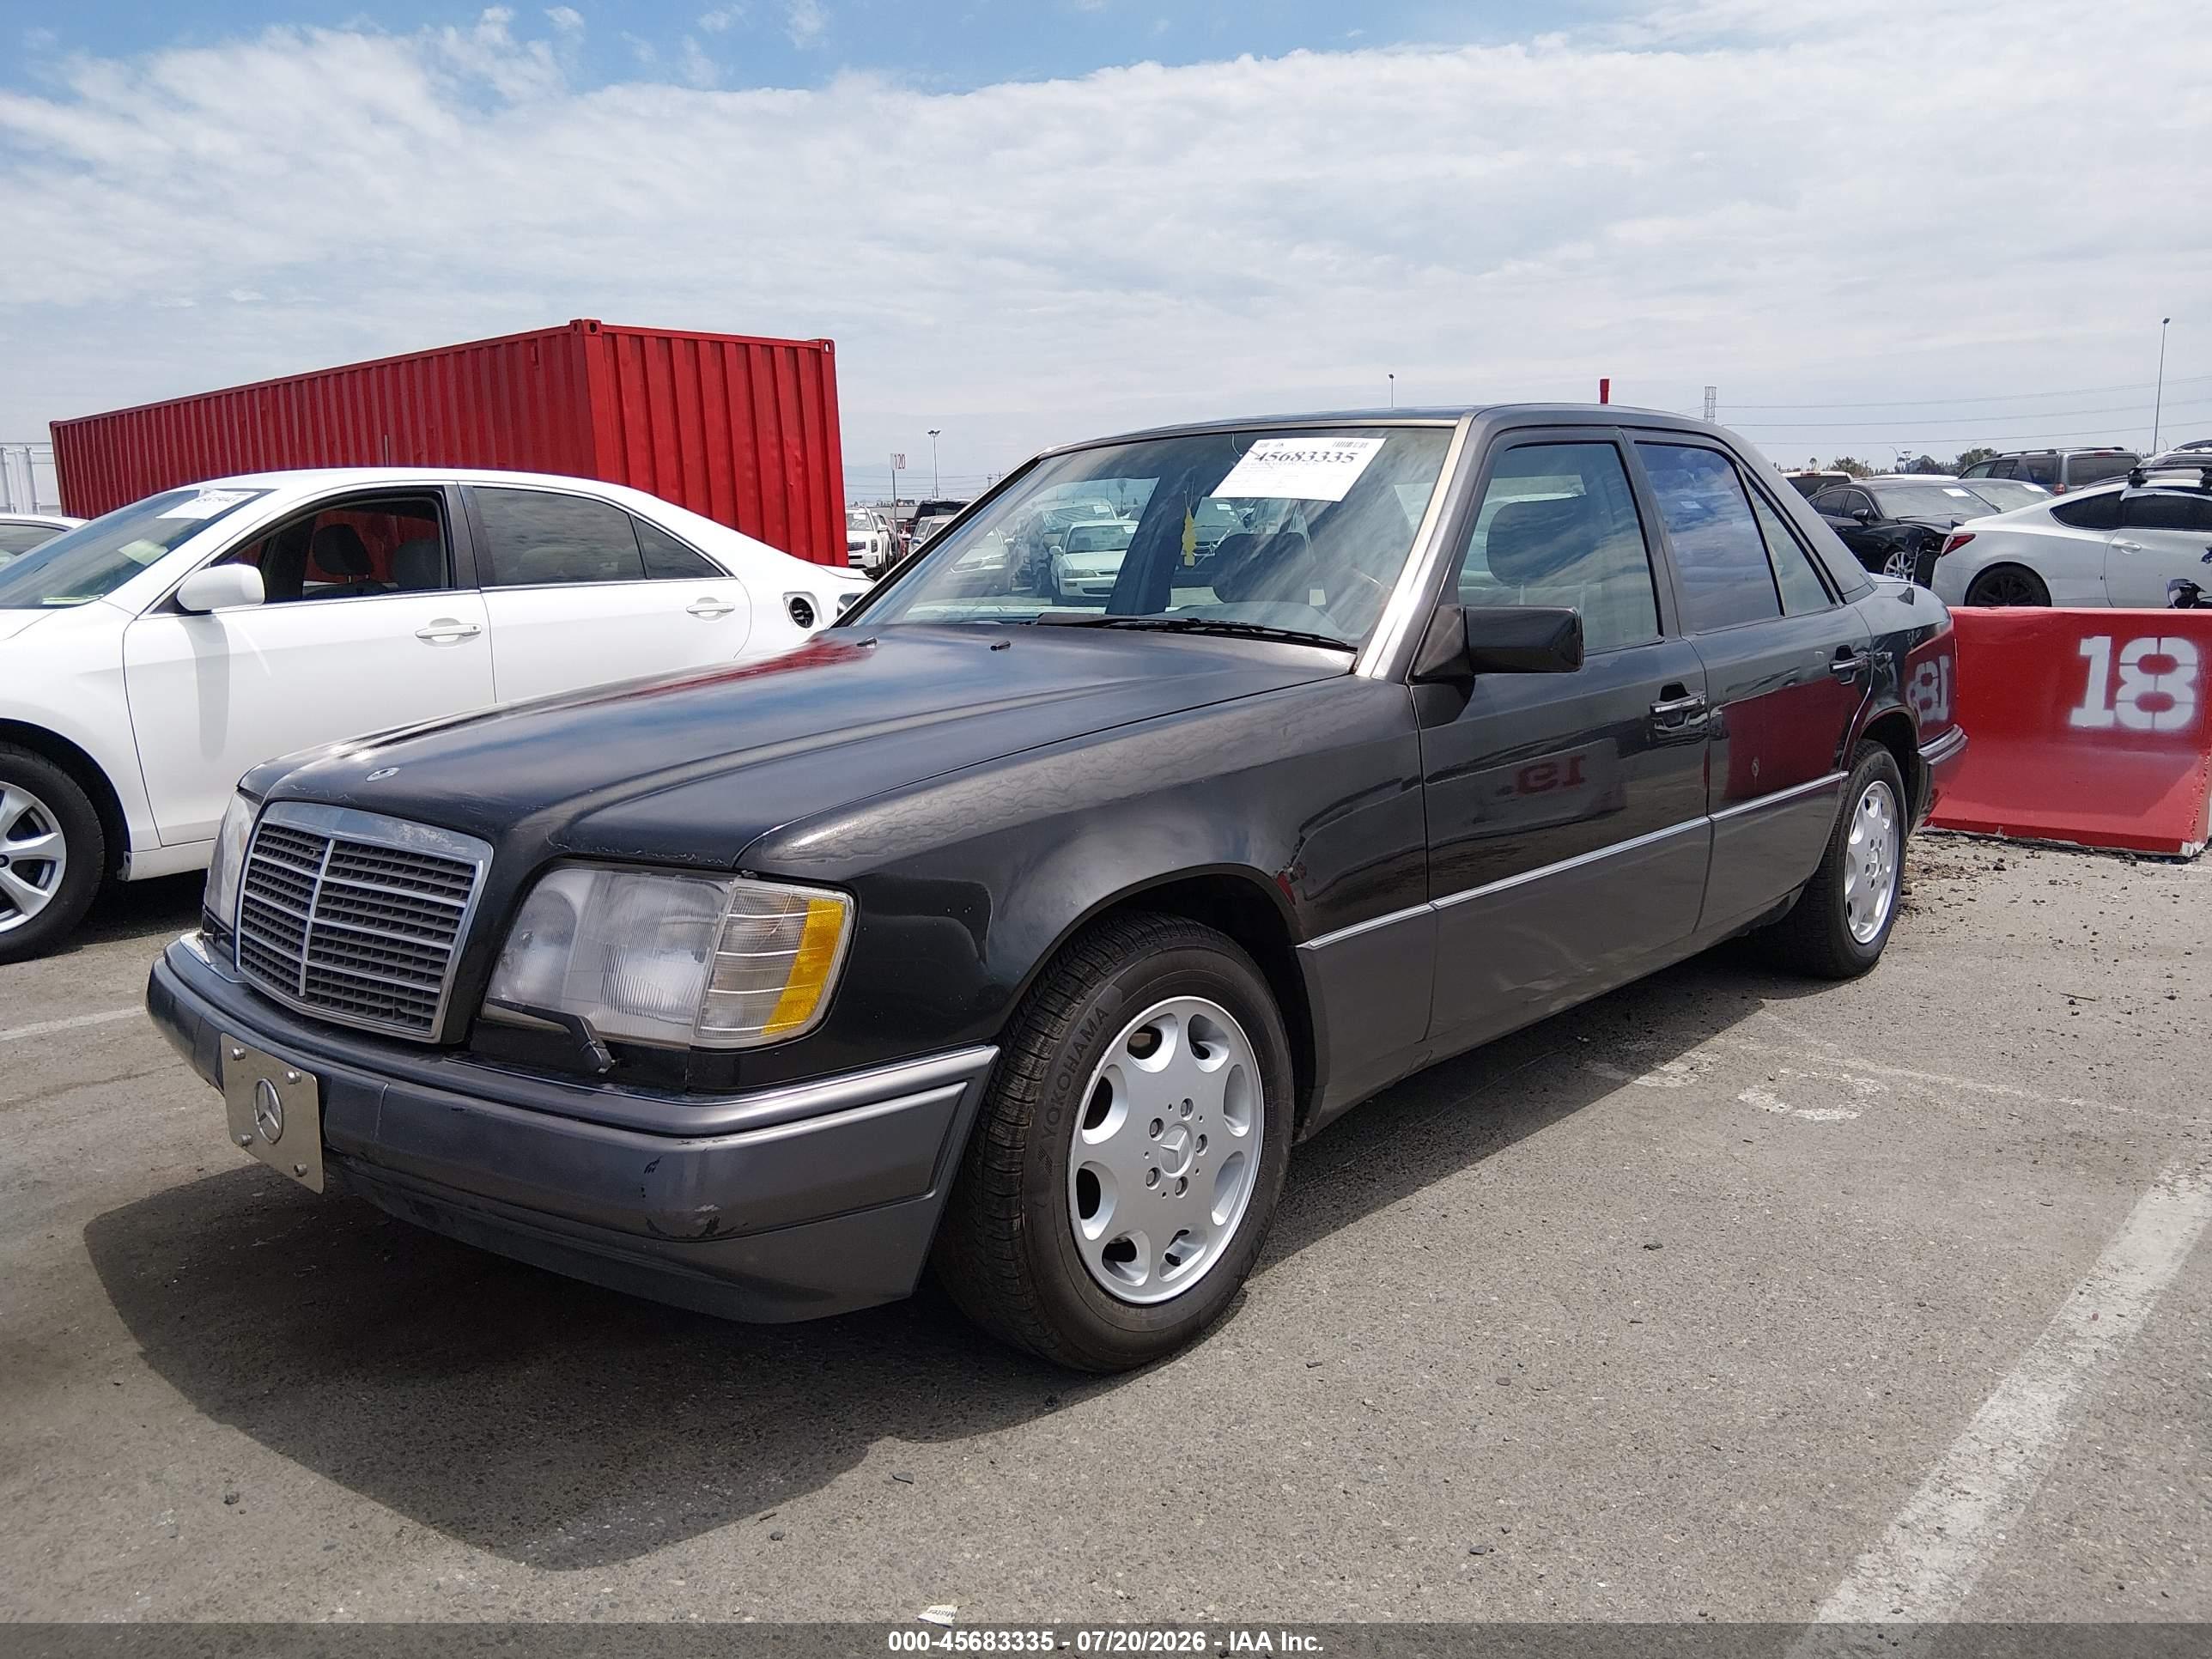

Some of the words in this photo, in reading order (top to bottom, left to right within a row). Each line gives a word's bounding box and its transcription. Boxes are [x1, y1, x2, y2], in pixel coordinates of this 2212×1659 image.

[894, 453, 906, 470] 120
[1255, 451, 1358, 464] 45683335
[2069, 635, 2199, 730] 18
[1042, 1004, 1110, 1141] YOKOHAMA
